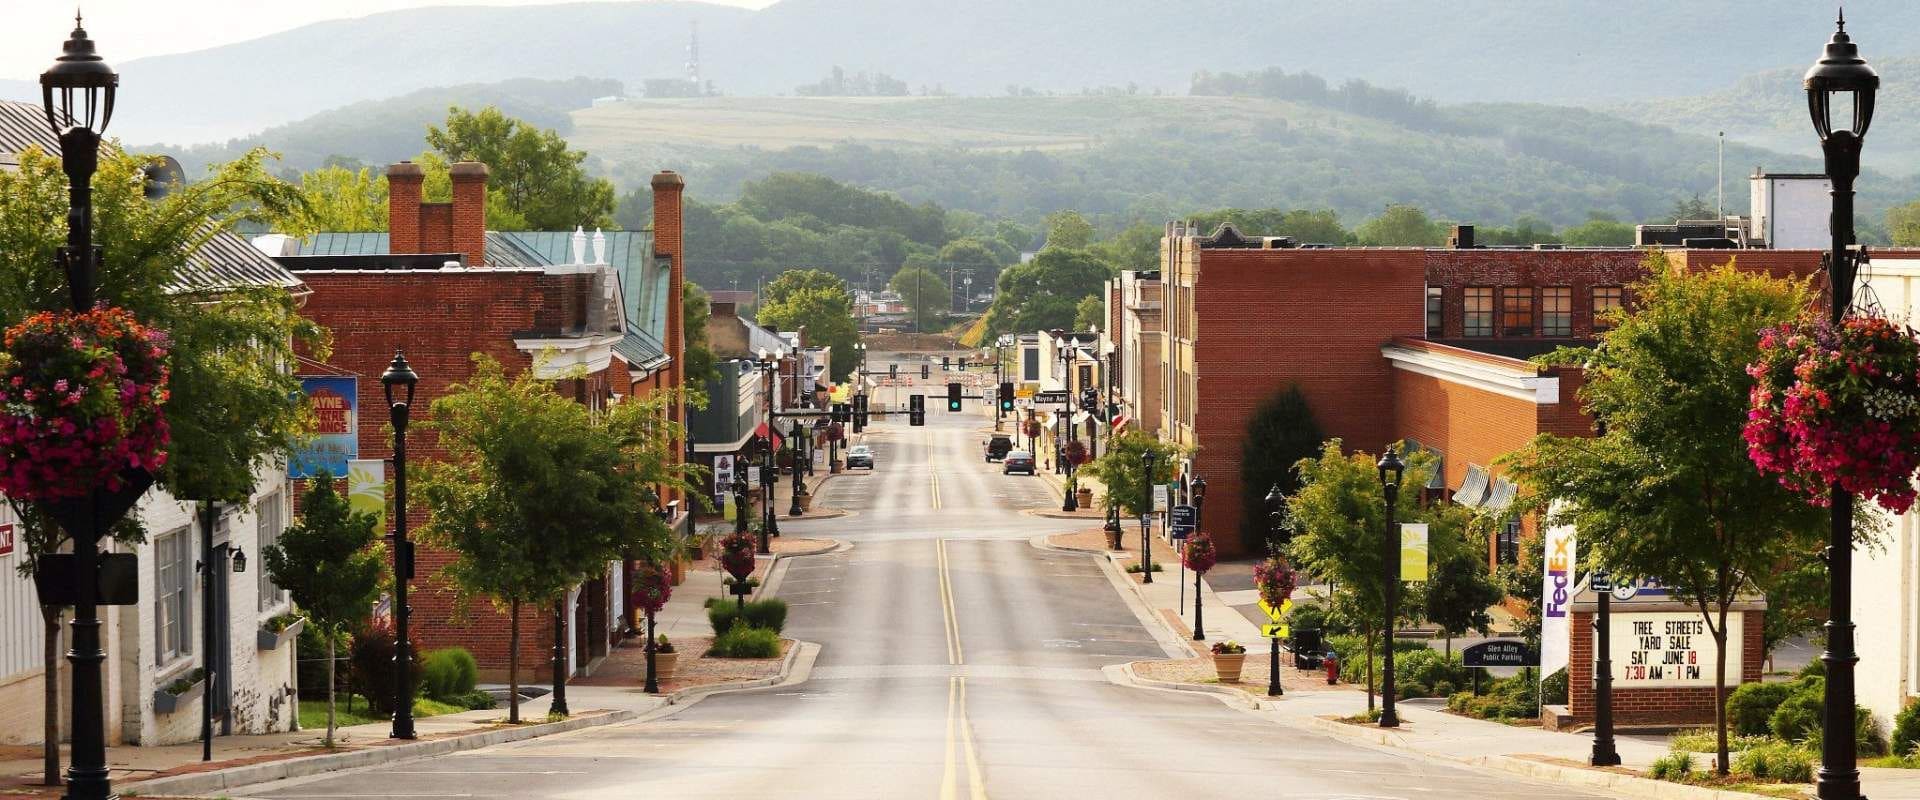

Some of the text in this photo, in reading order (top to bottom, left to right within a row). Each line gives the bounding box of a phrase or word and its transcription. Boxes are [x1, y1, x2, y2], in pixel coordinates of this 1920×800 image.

[309, 396, 343, 409] AYNE
[1546, 538, 1568, 617] FedEx
[1633, 621, 1703, 635] TREE STREETS
[1487, 645, 1518, 654] Glen Alley
[1640, 636, 1691, 650] YARD SALE
[1483, 653, 1523, 662] Public Parking
[1631, 651, 1697, 665] SAT JUNE 18
[1625, 666, 1646, 680] 7:30
[1649, 666, 1663, 680] AM
[1677, 666, 1681, 680] 1
[1686, 666, 1700, 680] PM
